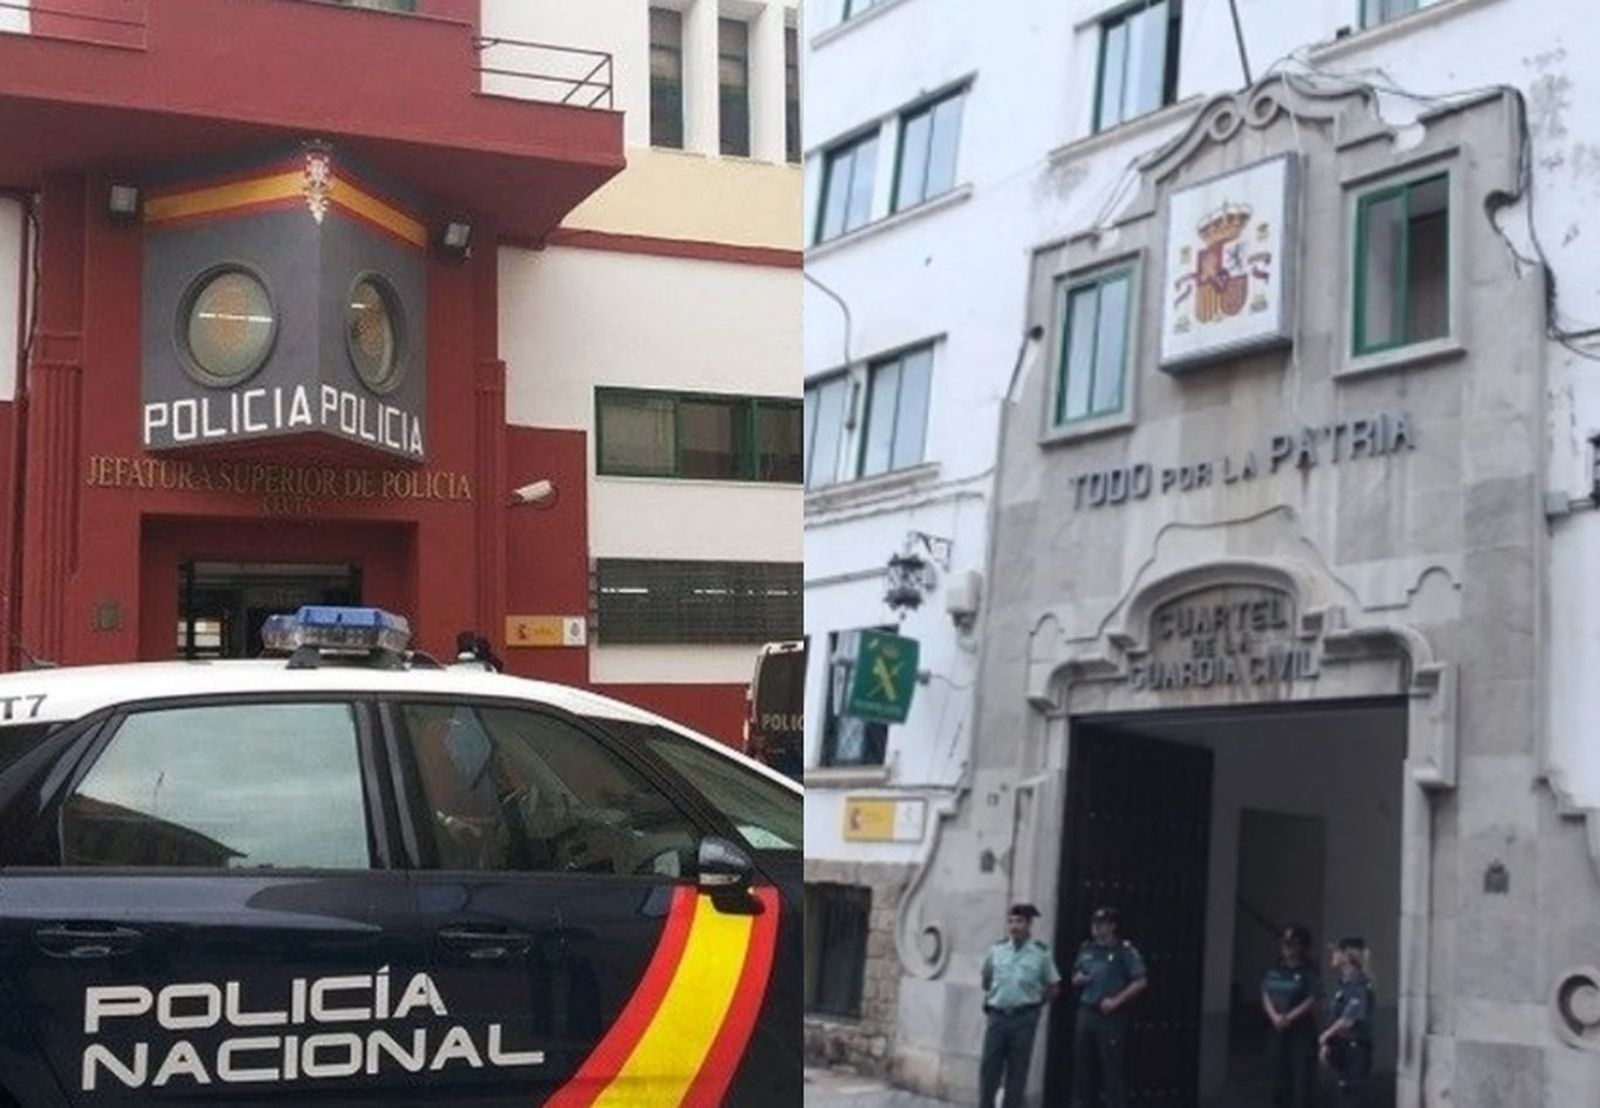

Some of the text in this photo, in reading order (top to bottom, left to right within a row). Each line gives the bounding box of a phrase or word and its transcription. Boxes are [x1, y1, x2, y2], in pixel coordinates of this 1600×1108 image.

[144, 385, 312, 445] POLICIA
[321, 384, 424, 456] POLICIA
[86, 455, 472, 499] JEFATURA SUPERIOR DE POLICIA
[1069, 410, 1416, 510] TODO POR LA PATRIA
[1158, 598, 1287, 640] CUARTEL
[1128, 645, 1320, 692] GUARDIA CIVIL
[1191, 637, 1216, 658] DE
[0, 693, 47, 719] T7
[84, 965, 448, 1034] POLICÍA
[81, 1024, 545, 1091] NACIONAL
